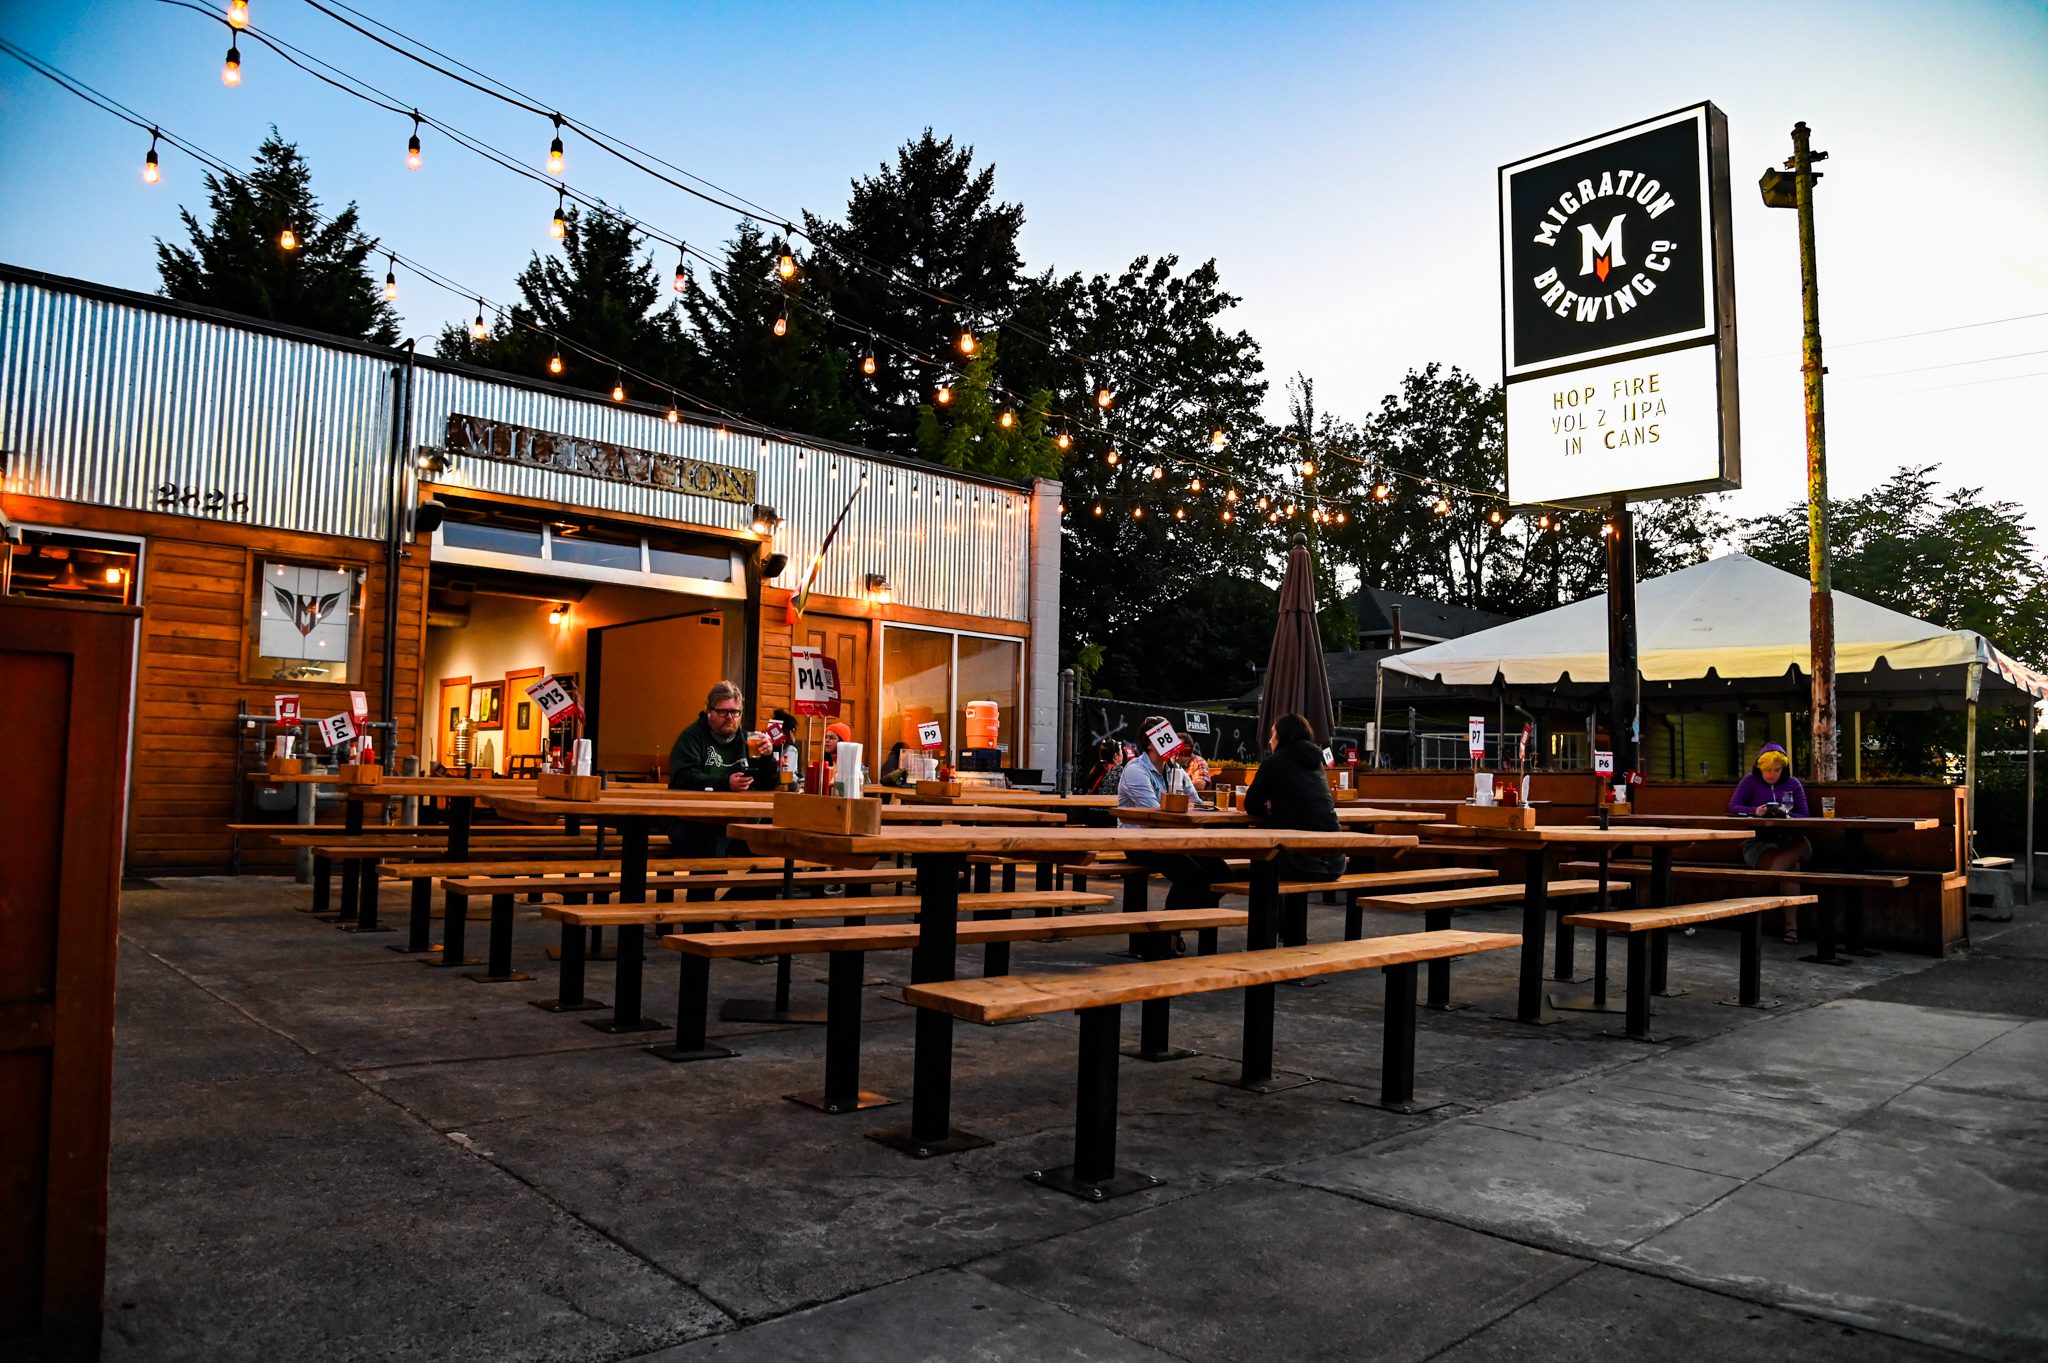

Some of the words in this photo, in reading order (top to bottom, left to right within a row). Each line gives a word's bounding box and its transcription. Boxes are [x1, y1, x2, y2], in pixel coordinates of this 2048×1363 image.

[1533, 169, 1676, 247] MIGRATION
[1533, 266, 1657, 323] BREWING
[1553, 387, 1595, 410] HOP
[1613, 373, 1660, 399] FIRE
[1552, 412, 1587, 434] VOL
[1623, 398, 1667, 423] IIPA
[1564, 436, 1582, 457] IN
[1603, 424, 1661, 450] CANS
[157, 481, 250, 515] 2828
[798, 667, 824, 690] P14
[537, 687, 566, 710] P13
[331, 716, 349, 740] P12
[1188, 721, 1207, 731] PARKING
[1193, 714, 1201, 723] NO
[923, 729, 937, 740] P9
[1156, 732, 1174, 748] P8
[1471, 730, 1481, 744] P7
[1598, 758, 1610, 769] P6
